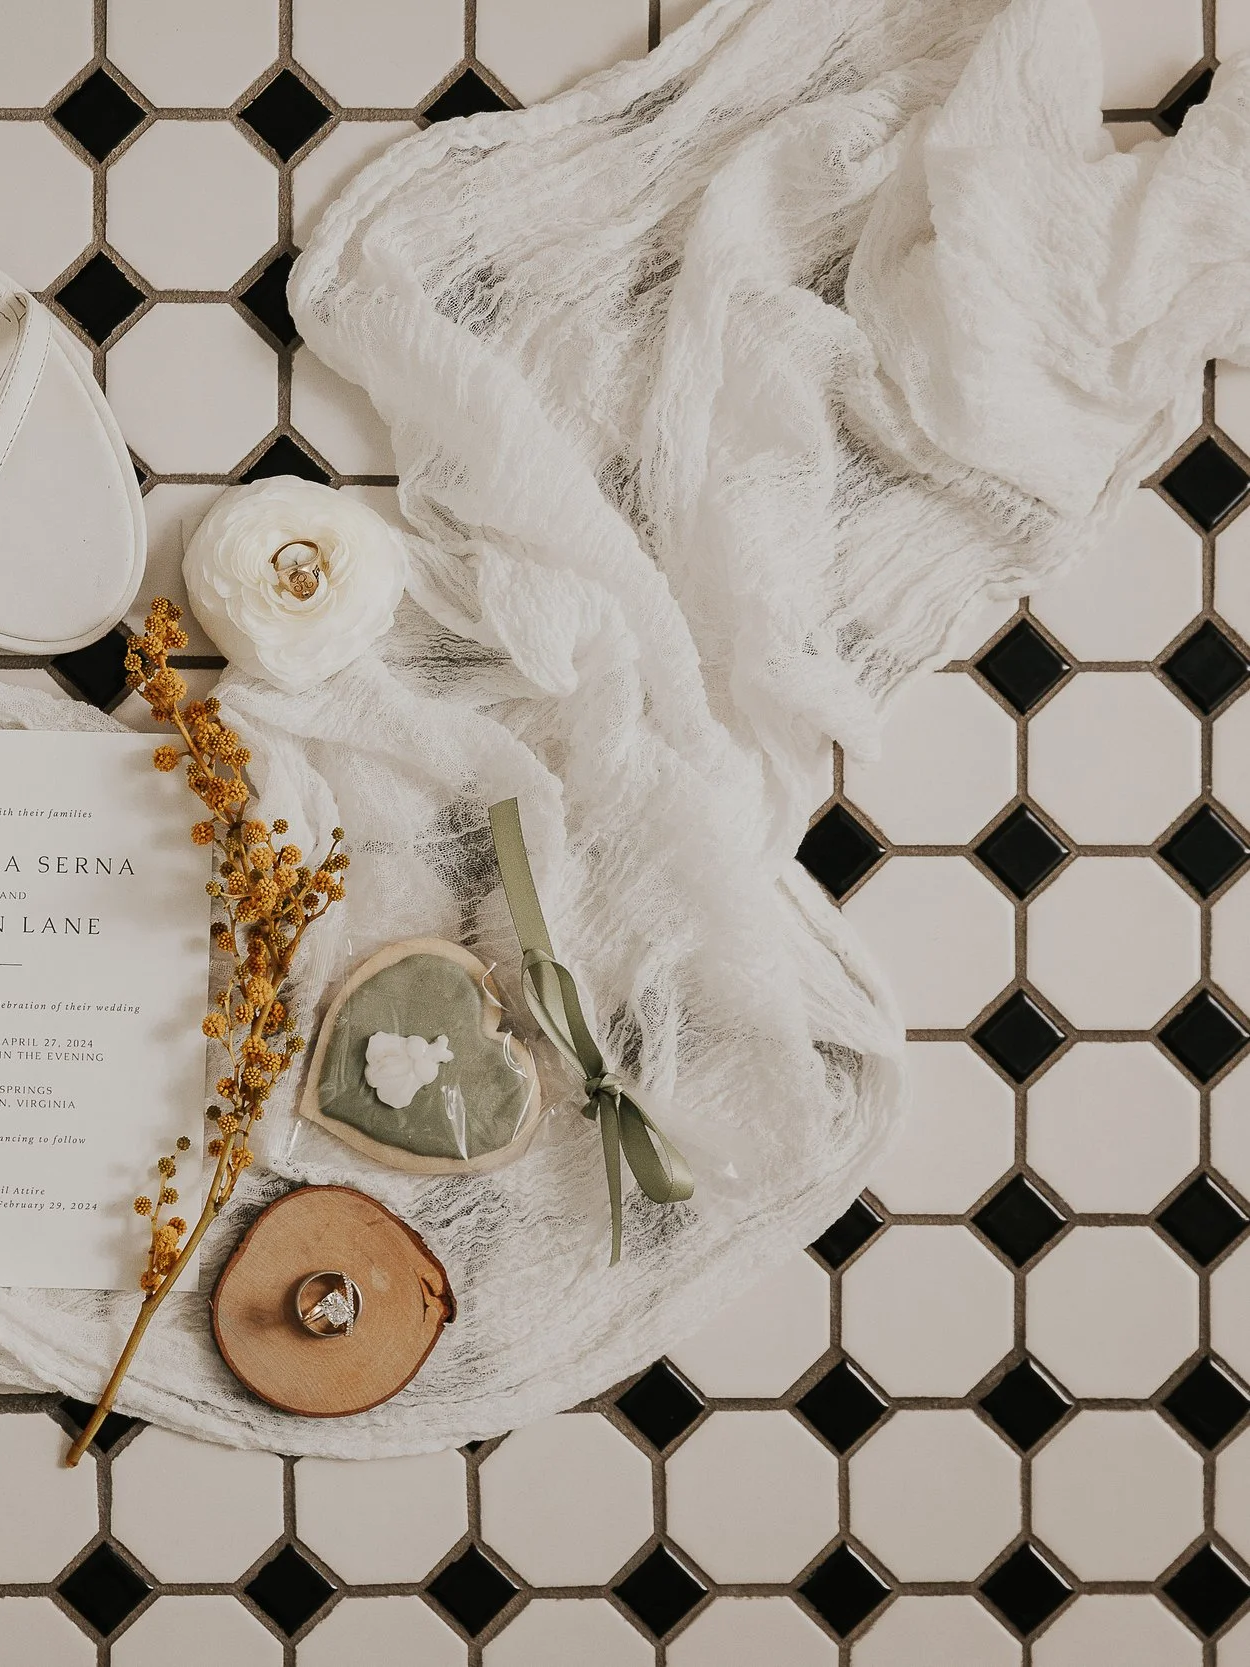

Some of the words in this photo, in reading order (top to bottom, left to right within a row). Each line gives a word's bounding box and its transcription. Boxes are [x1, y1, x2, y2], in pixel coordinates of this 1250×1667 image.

[18, 807, 45, 818] their
[48, 808, 93, 819] families
[37, 855, 135, 876] SERNA
[0, 891, 27, 900] AND
[23, 916, 101, 935] LANE
[51, 1002, 62, 1012] of
[65, 1002, 92, 1012] their
[96, 1003, 141, 1014] wedding
[2, 1037, 39, 1047] APRIL
[44, 1038, 61, 1048] 27,
[66, 1038, 93, 1048] 2024
[17, 1051, 42, 1060] THE
[47, 1051, 104, 1062] EVENING
[0, 1085, 53, 1095] SPRINGS
[16, 1098, 76, 1109] VIRGINIA
[52, 1134, 86, 1145] follow
[13, 1186, 46, 1196] Attire
[49, 1201, 66, 1211] 29,
[70, 1202, 98, 1211] 2024
